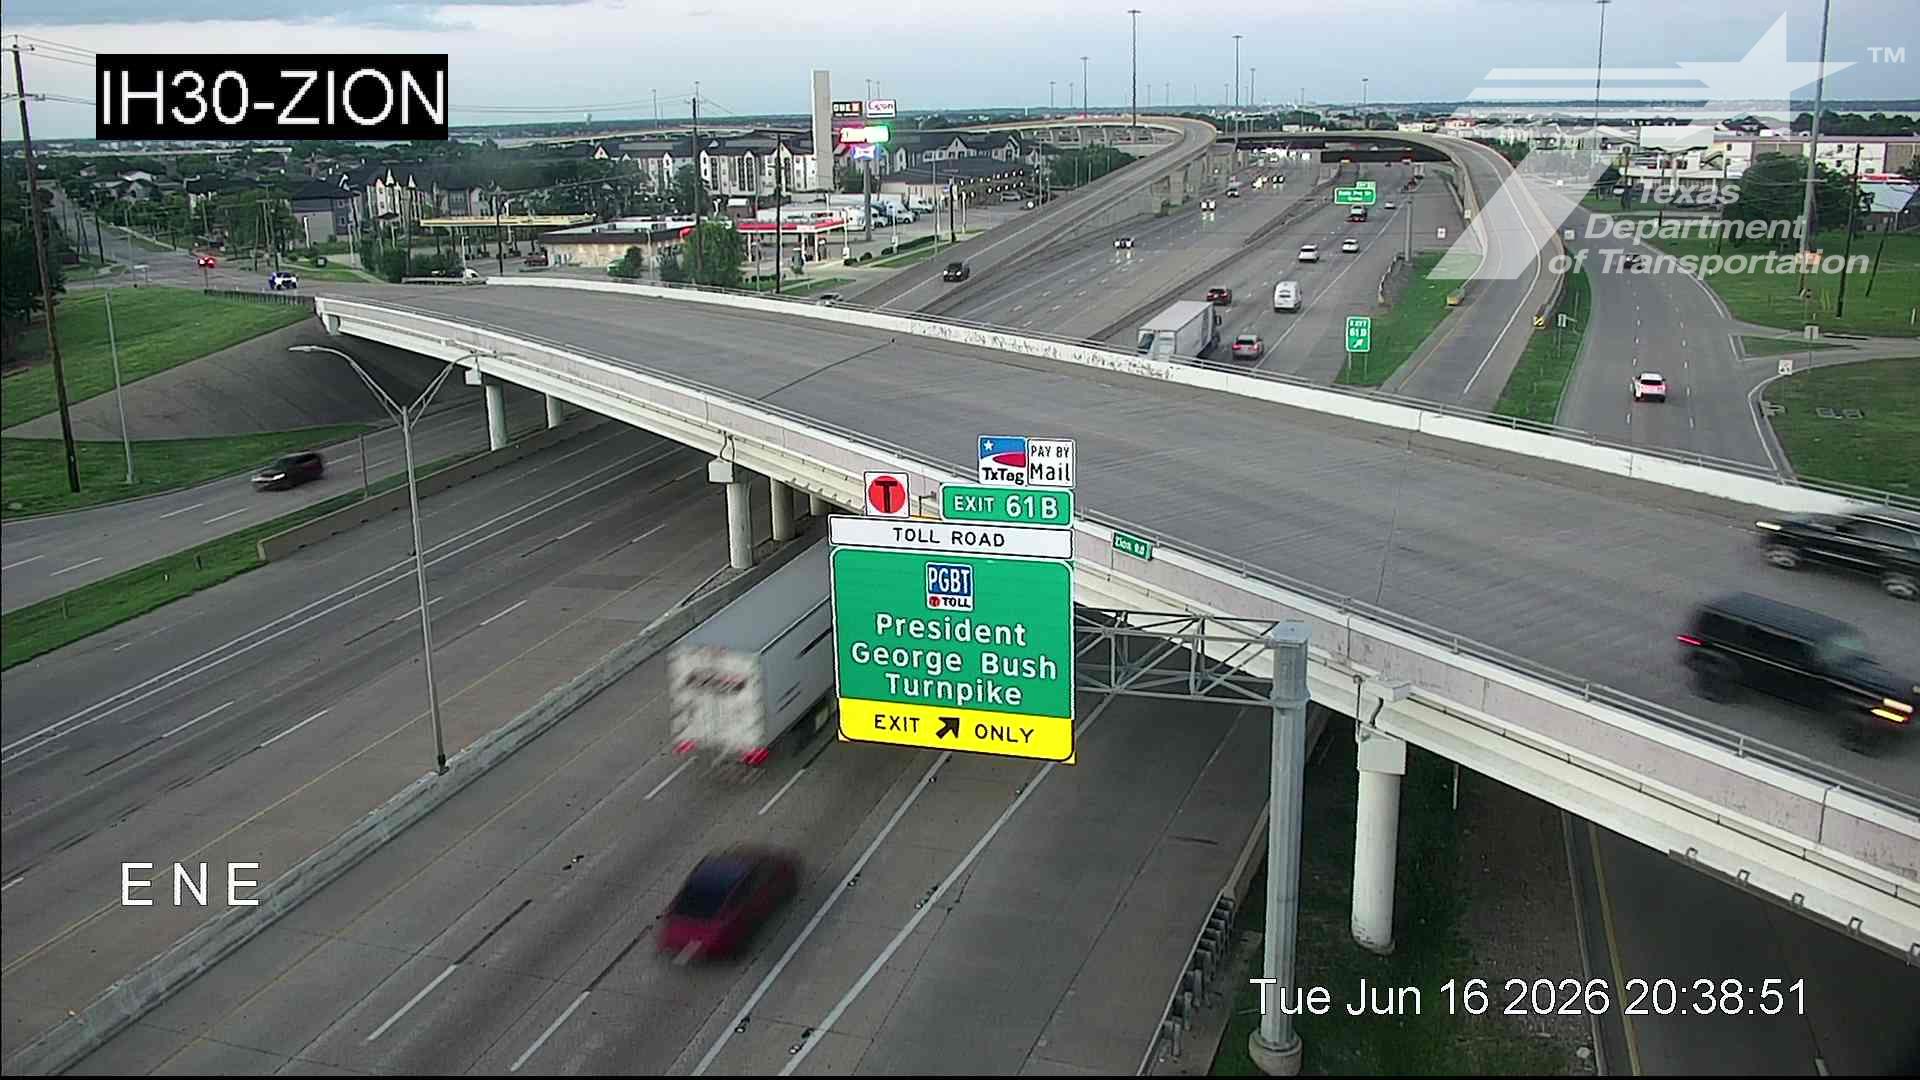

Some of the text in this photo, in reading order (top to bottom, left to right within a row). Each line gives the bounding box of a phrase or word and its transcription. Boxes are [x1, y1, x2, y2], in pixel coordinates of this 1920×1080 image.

[1031, 445, 1070, 458] PAY BY
[982, 467, 1025, 486] TxTag
[1030, 463, 1071, 481] Mail
[954, 494, 1059, 519] EXIT 61B
[893, 527, 1005, 547] TOLL ROAD
[928, 566, 971, 594] PGBT
[941, 597, 971, 608] TOLL
[875, 613, 1026, 647] President
[851, 642, 1058, 680] George Bush
[885, 672, 1022, 706] Turnpike
[874, 713, 1035, 744] EXIT ONLY
